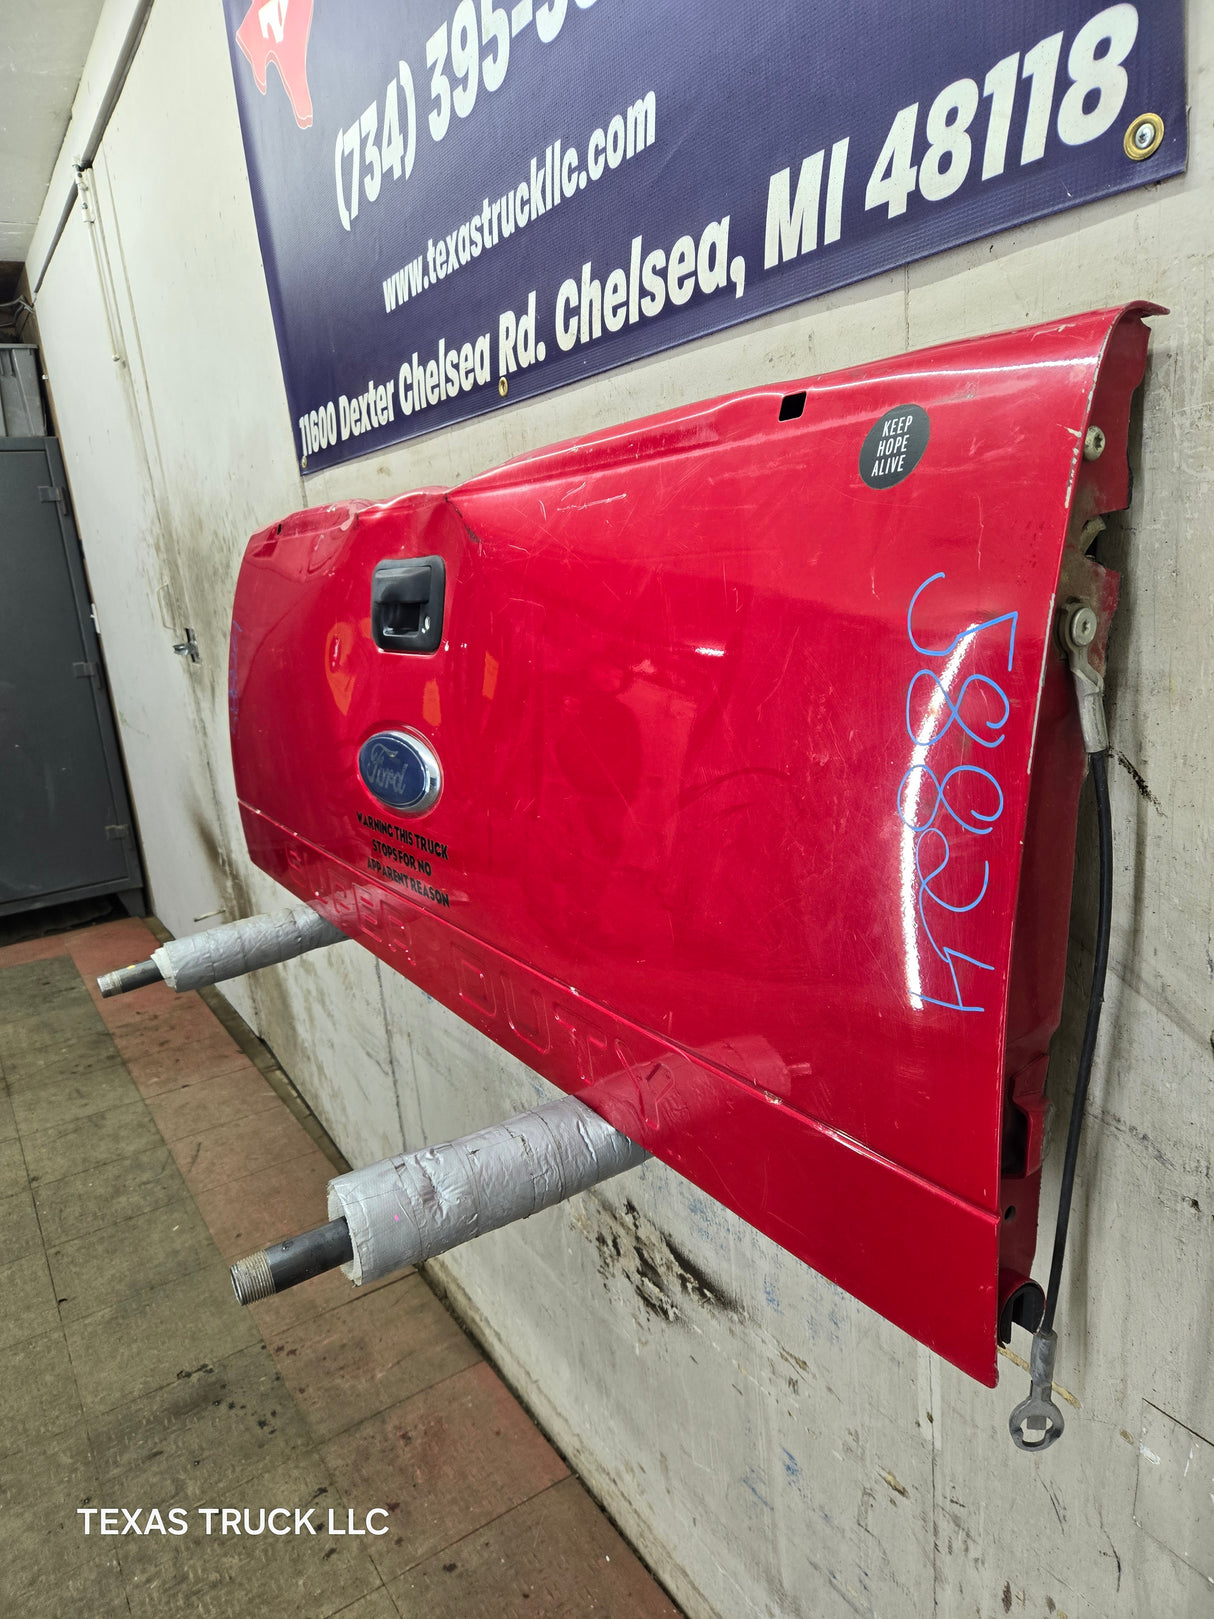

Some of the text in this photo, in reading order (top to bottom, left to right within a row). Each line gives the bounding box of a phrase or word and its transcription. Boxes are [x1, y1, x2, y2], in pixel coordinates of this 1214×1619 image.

[335, 0, 598, 231] (734) 395-
[382, 90, 656, 313] www.texastruckllc.com
[299, 2, 1139, 457] 11600 Dexter Chelsea Rd. Chelsea, MI 48118
[876, 434, 910, 457] HOPE
[882, 415, 913, 437] KEEP
[871, 455, 906, 477] ALIVE
[366, 742, 409, 795] Ford
[896, 572, 1018, 1012] 58824
[356, 811, 449, 861] WARNING THIS TRUCK
[371, 839, 432, 877] STOPS FOR NO
[284, 840, 417, 967] SUPER
[367, 857, 450, 908] APPARENT REASON
[451, 942, 675, 1130] DUTY
